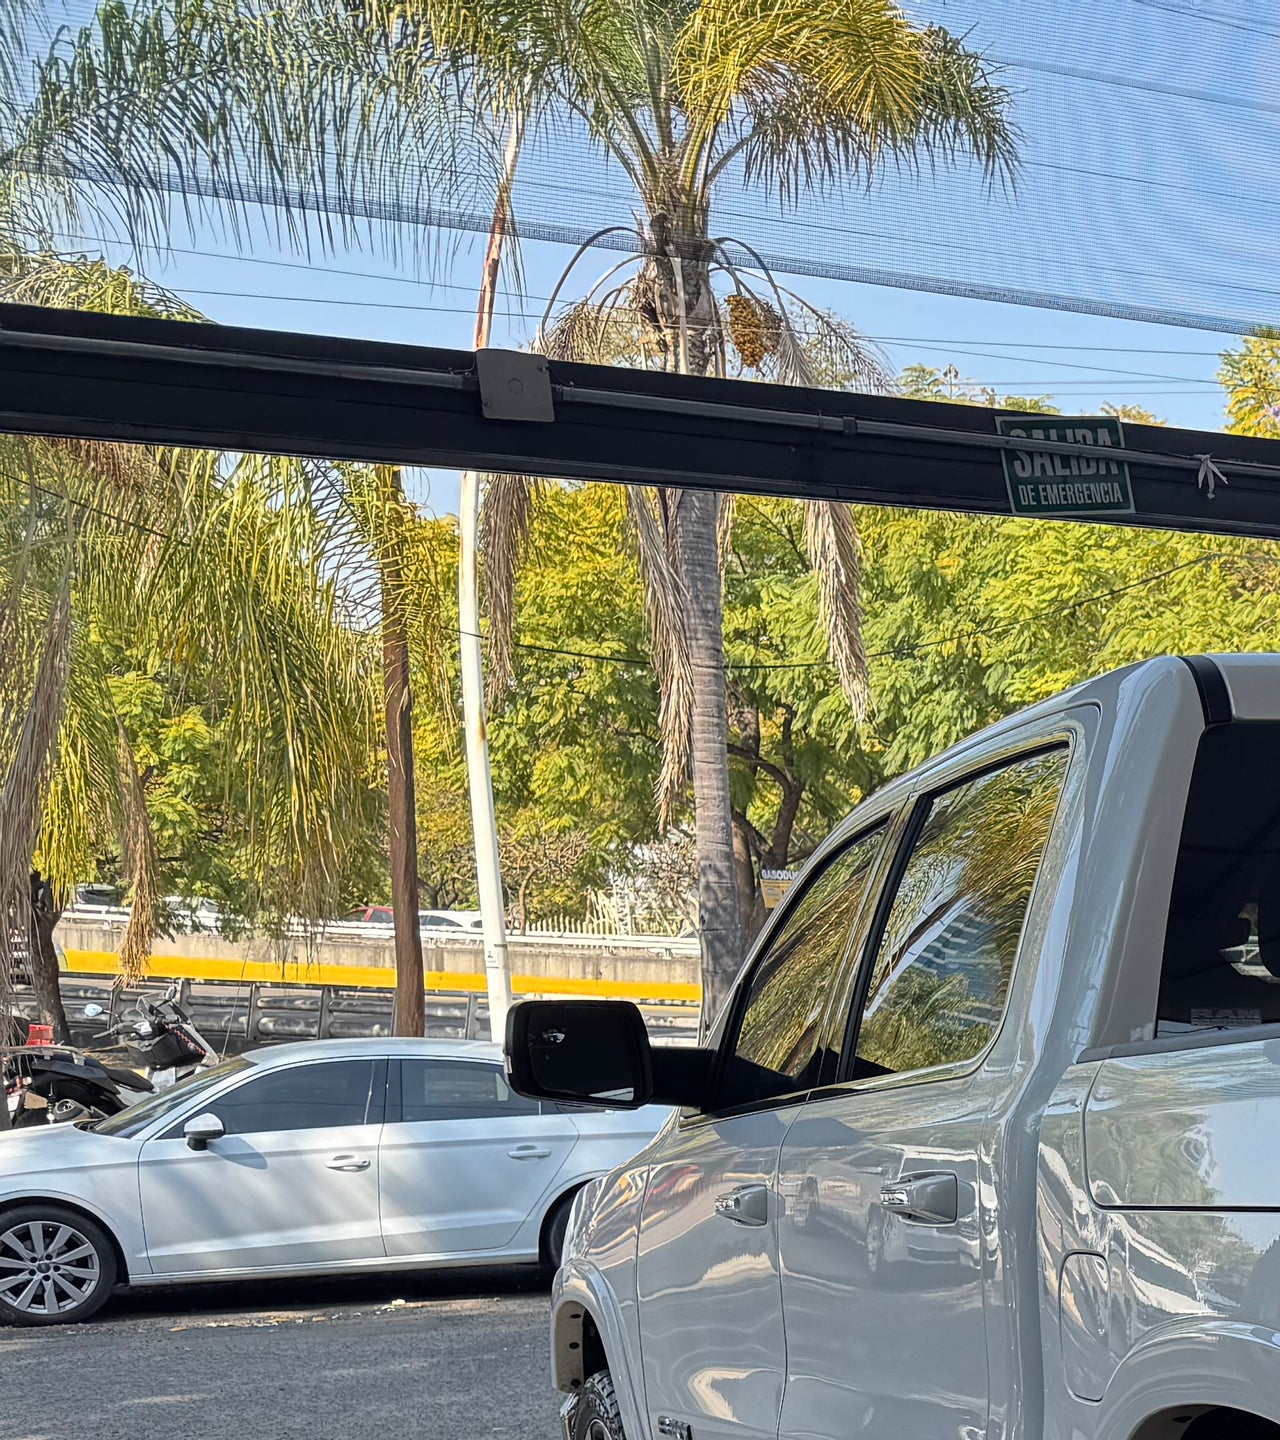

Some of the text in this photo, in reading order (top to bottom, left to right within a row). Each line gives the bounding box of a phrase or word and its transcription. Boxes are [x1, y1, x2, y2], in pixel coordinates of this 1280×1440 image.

[1009, 428, 1119, 478] SALIDA
[1018, 482, 1123, 506] DE EMERGENCIA
[761, 869, 798, 880] GASODU
